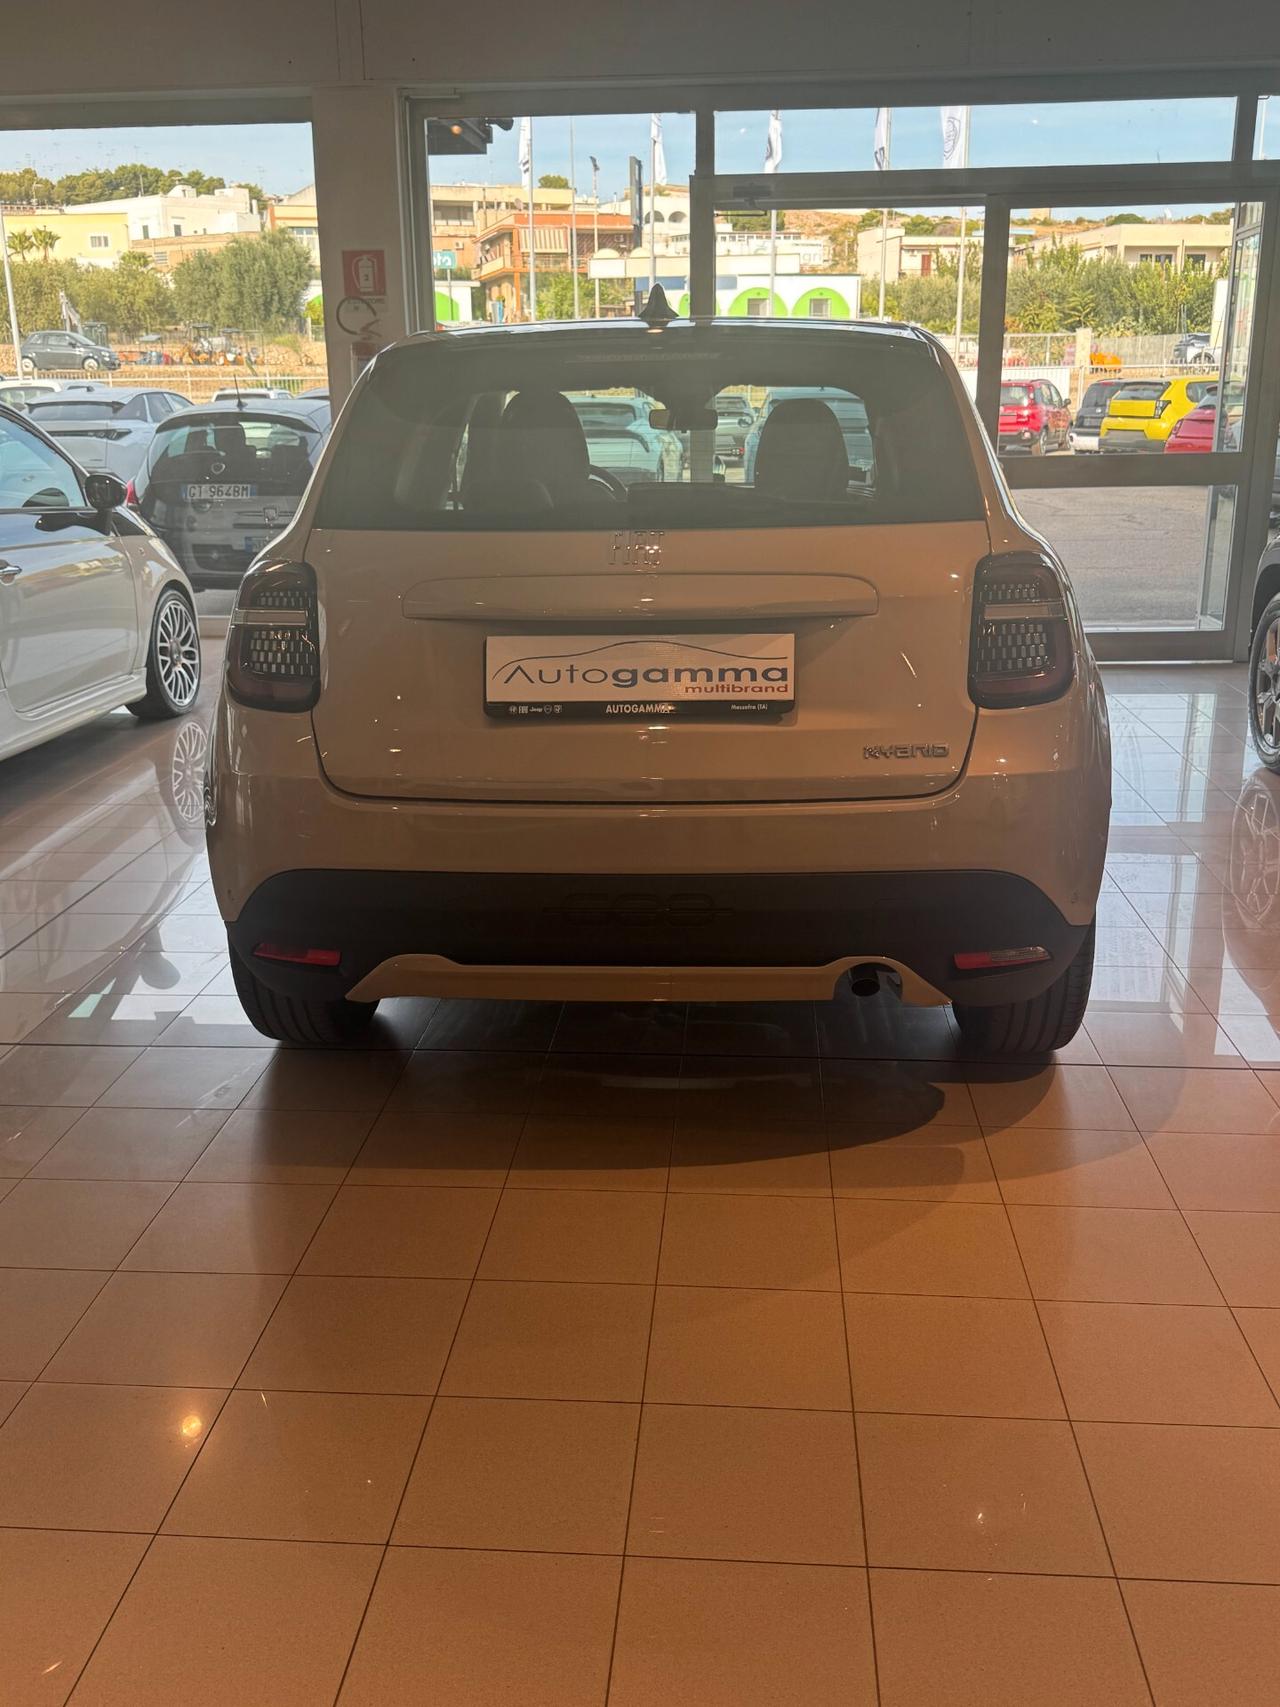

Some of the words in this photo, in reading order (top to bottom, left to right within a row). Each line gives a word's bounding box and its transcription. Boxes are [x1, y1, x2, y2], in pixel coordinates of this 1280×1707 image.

[503, 664, 789, 689] Autogamma
[684, 683, 789, 694] multibrand
[605, 703, 670, 714] AUTOGAMMA
[863, 743, 950, 759] HYBRID
